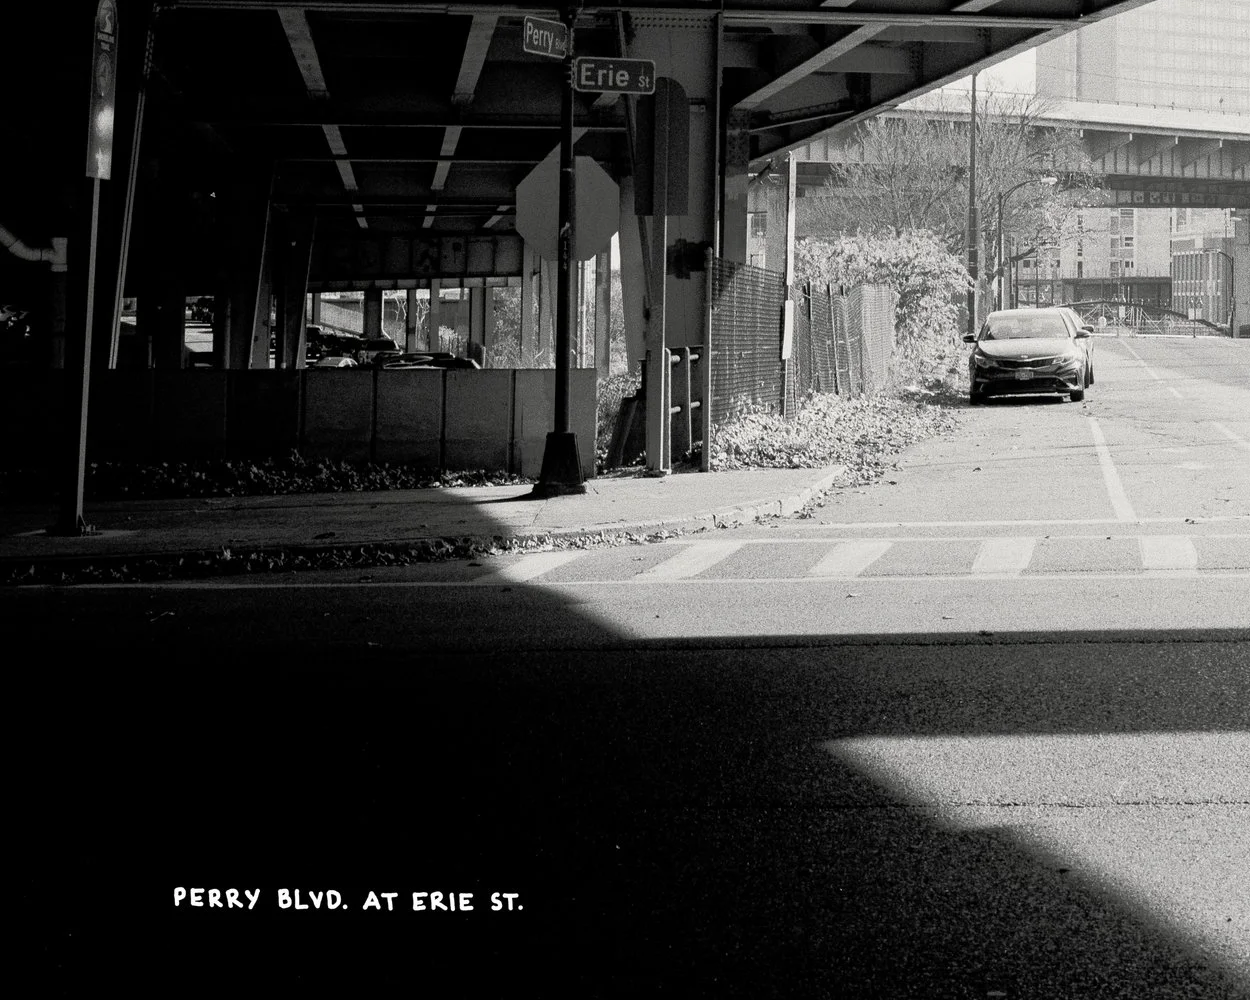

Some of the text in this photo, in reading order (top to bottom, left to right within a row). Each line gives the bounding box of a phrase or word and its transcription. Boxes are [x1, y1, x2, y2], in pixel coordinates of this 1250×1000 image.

[526, 22, 554, 53] Perry
[580, 63, 651, 88] Erie St
